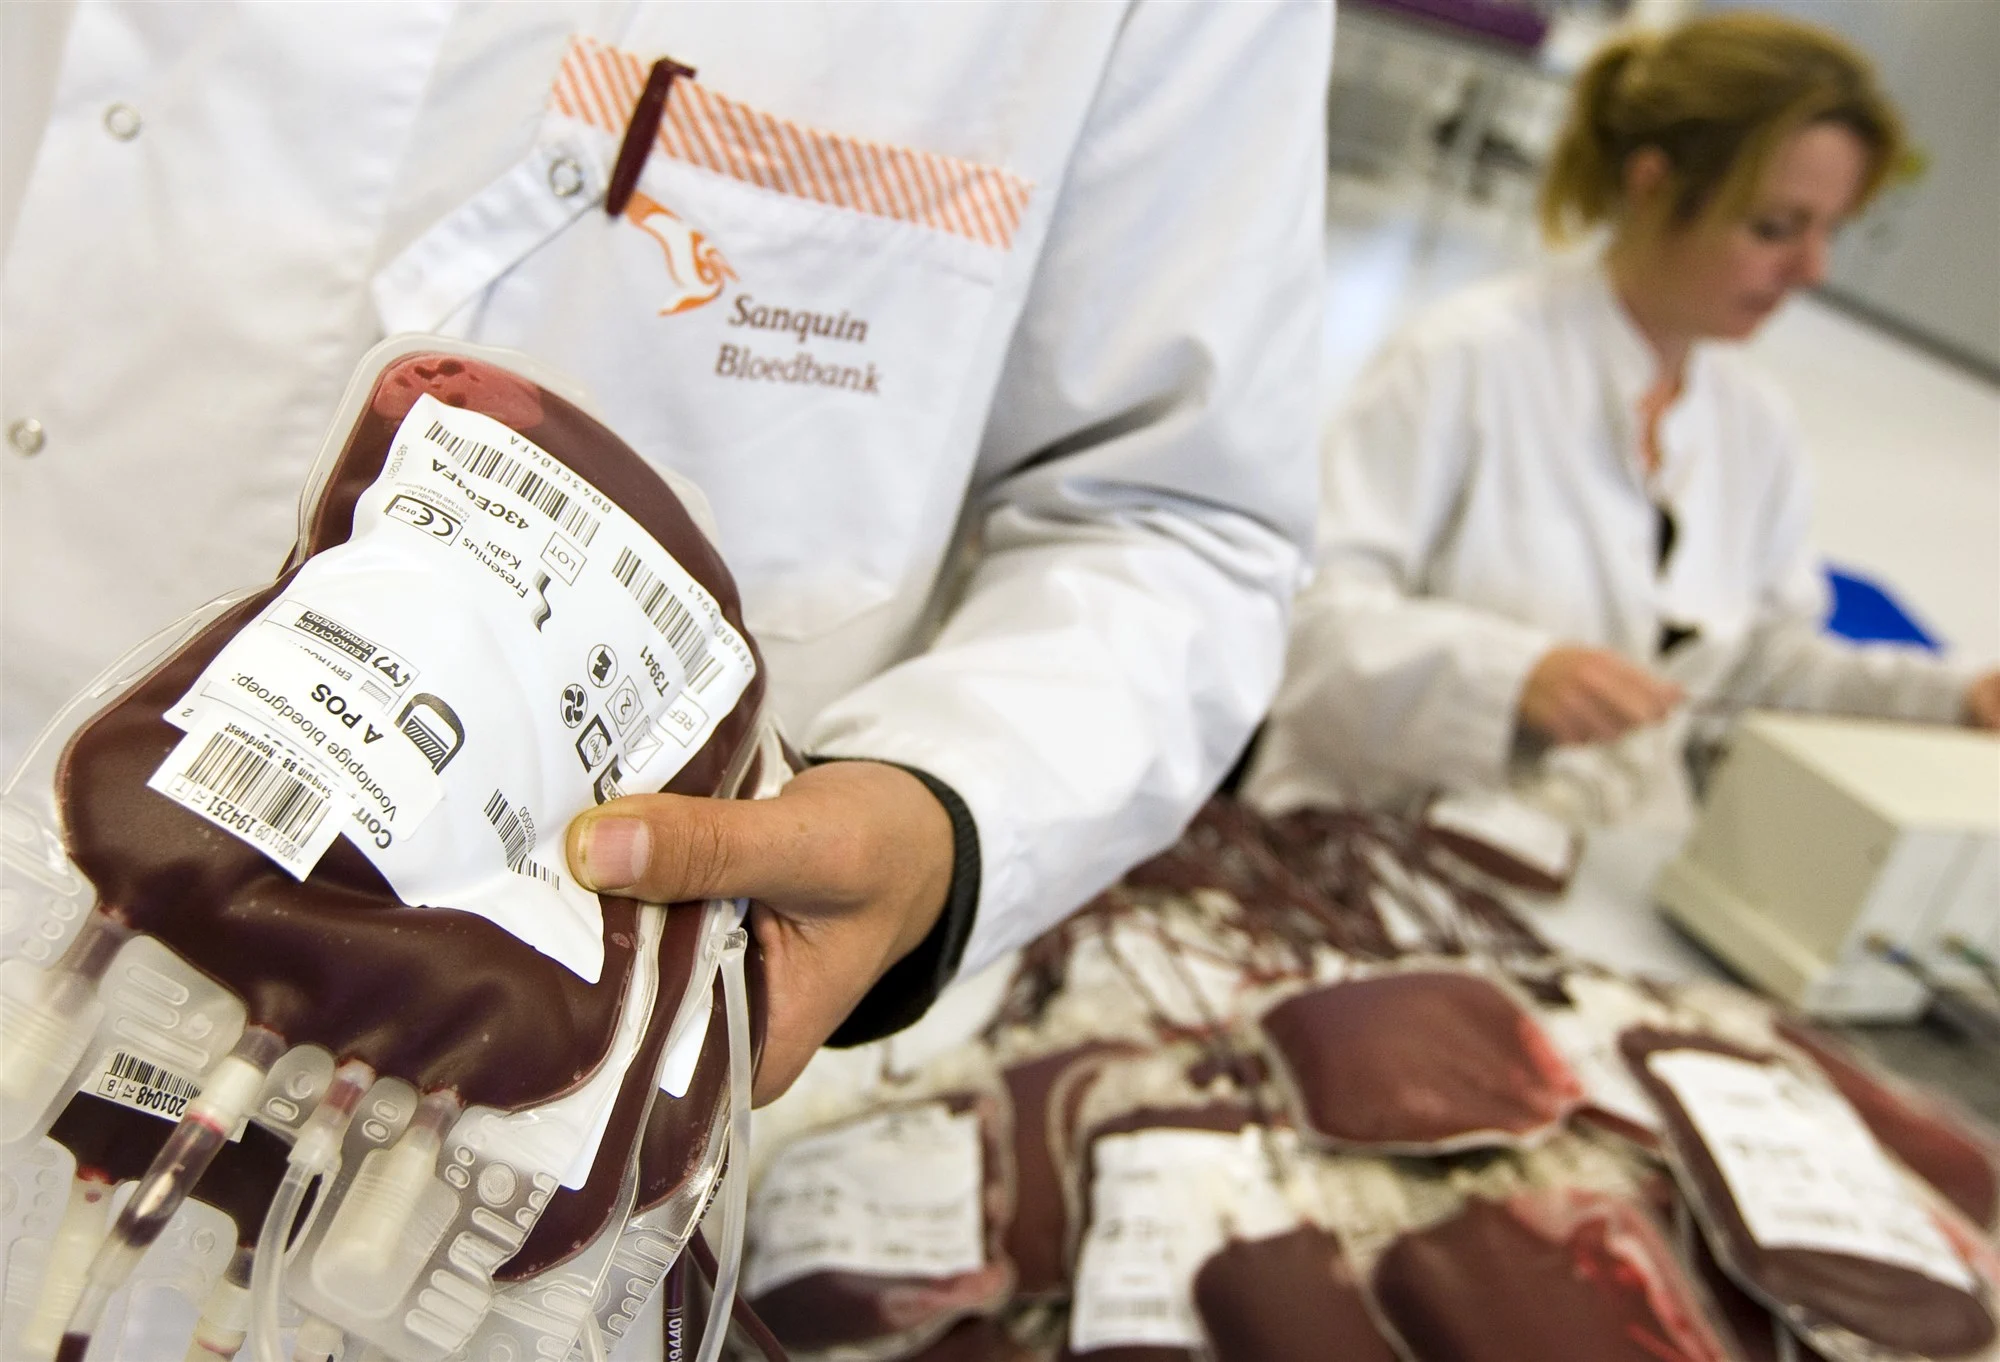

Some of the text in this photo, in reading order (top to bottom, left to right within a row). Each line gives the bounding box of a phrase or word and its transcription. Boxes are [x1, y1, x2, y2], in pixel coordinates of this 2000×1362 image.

[728, 294, 870, 345] Sanquin
[714, 342, 883, 395] Bloedbank
[395, 504, 417, 515] 0123
[432, 458, 529, 530] 43CE04FA
[462, 538, 529, 599] Fresenius
[486, 541, 522, 570] Kabi
[549, 545, 577, 572] LOT
[296, 619, 369, 661] LEUKOCYTEN
[306, 613, 375, 654] VERWIJDERD
[640, 645, 670, 697] T3941
[181, 708, 195, 718] 2
[311, 684, 385, 744] A POS
[668, 708, 695, 731] REF
[224, 722, 277, 759] Noordwest
[231, 672, 397, 822] Voorlopige bloedgroep:
[282, 758, 298, 773] BB
[299, 766, 333, 799] Sanquin
[206, 796, 258, 834] 194251
[255, 824, 272, 841] 09
[122, 1084, 136, 1098] 21
[136, 1086, 187, 1117] 201048
[668, 1317, 684, 1362] 9440
